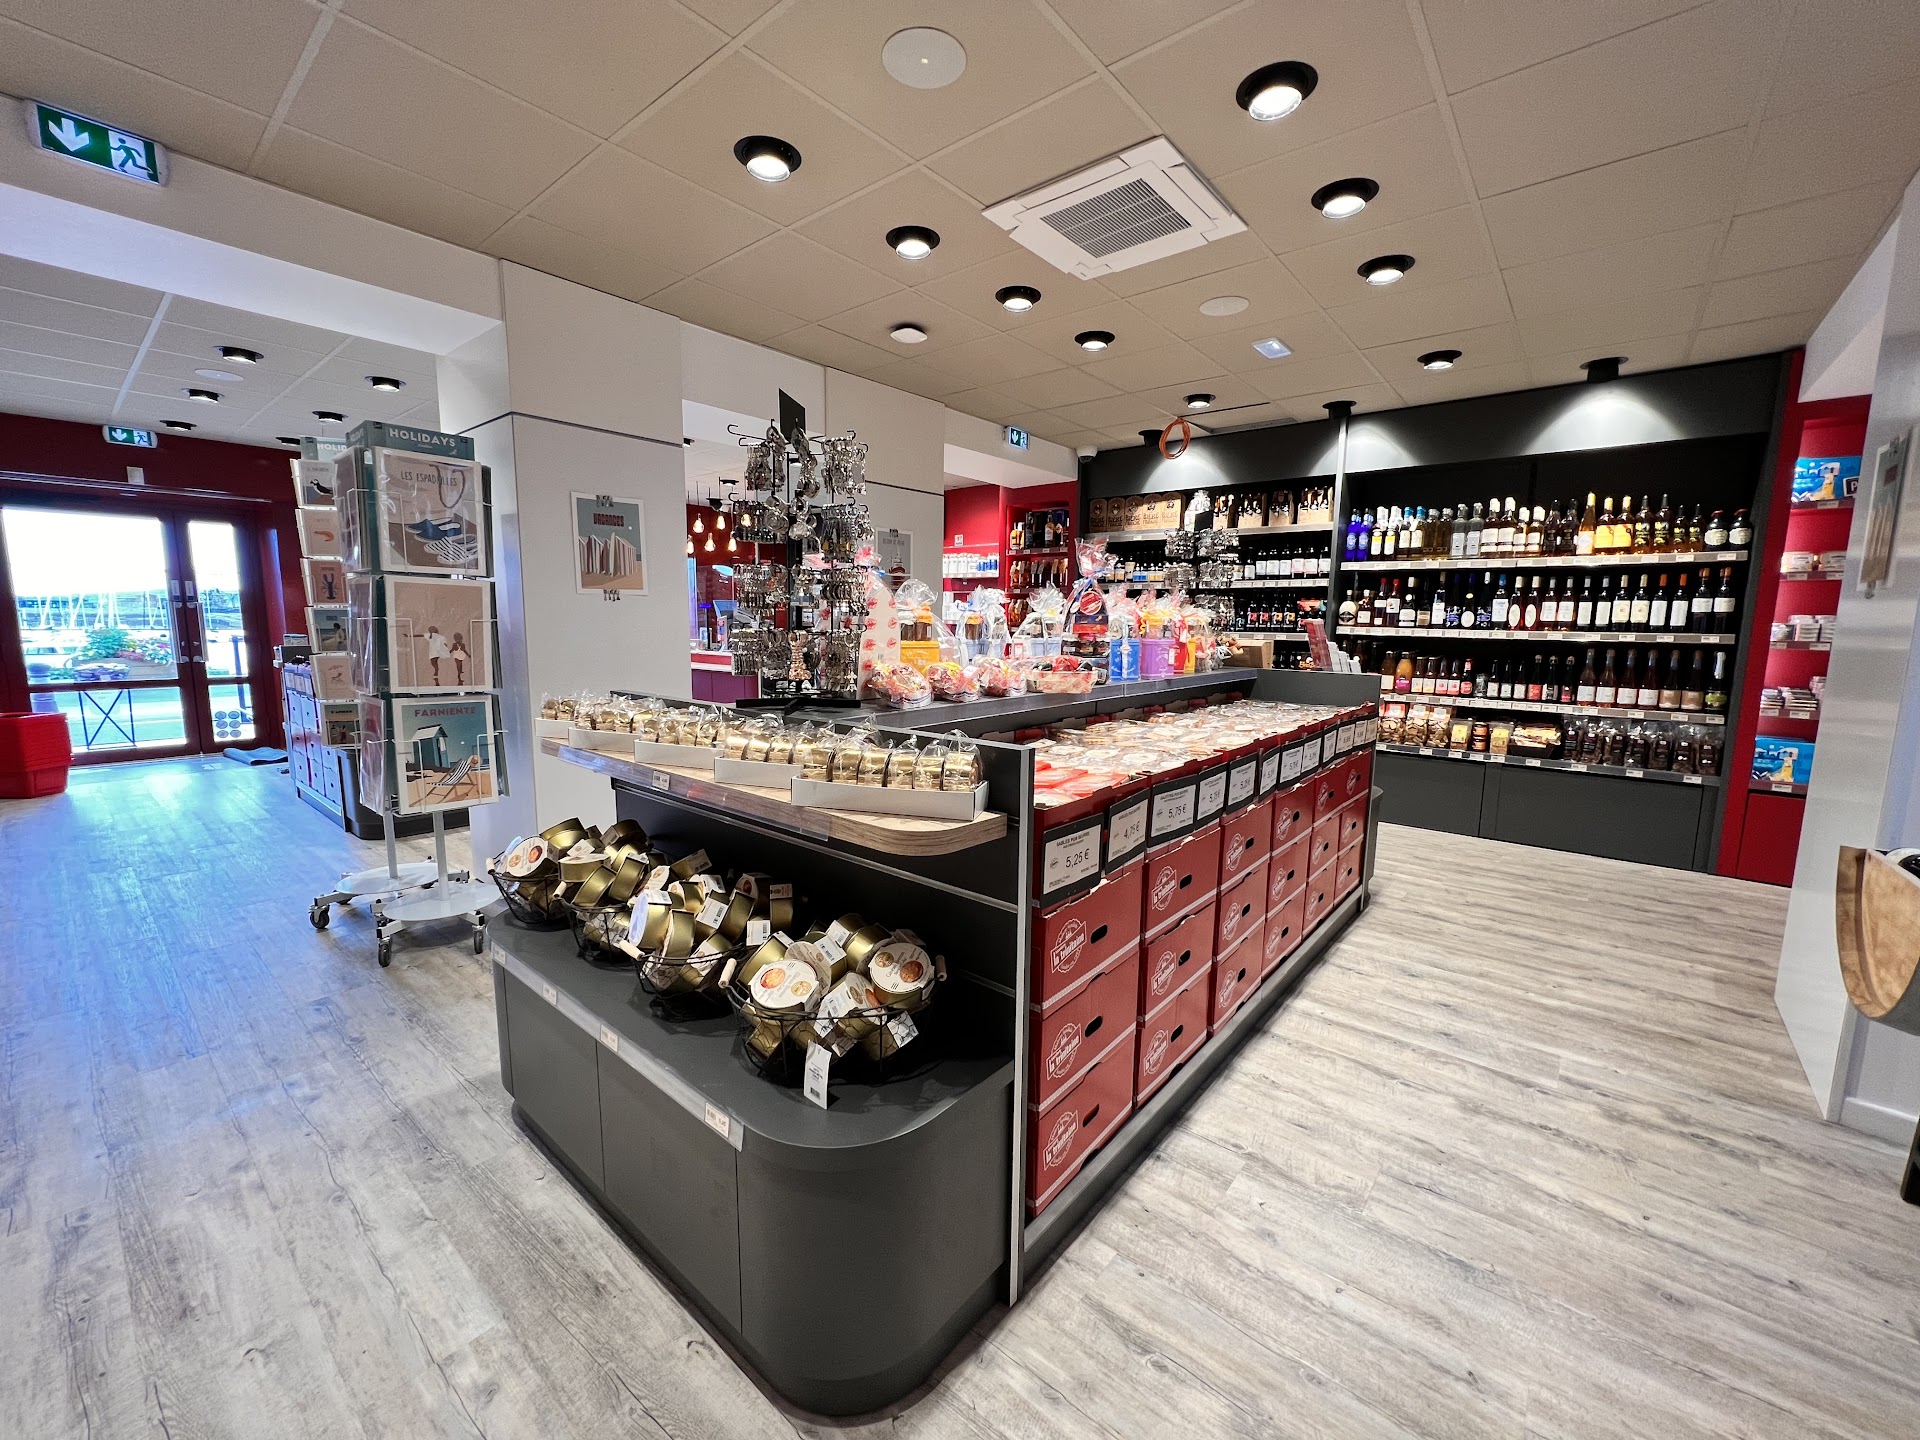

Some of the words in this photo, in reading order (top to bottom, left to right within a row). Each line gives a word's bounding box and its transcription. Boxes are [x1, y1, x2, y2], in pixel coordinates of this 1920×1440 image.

[389, 428, 456, 447] HOLIDAYS
[317, 443, 347, 452] HOLID
[400, 471, 413, 481] LES
[593, 513, 625, 527] VACANCES
[414, 706, 476, 718] FARNIENTE
[1168, 806, 1182, 819] 5,75
[1182, 803, 1187, 814] €
[1123, 823, 1136, 839] 4,75
[1065, 851, 1083, 868] 5,25
[1084, 848, 1090, 860] €
